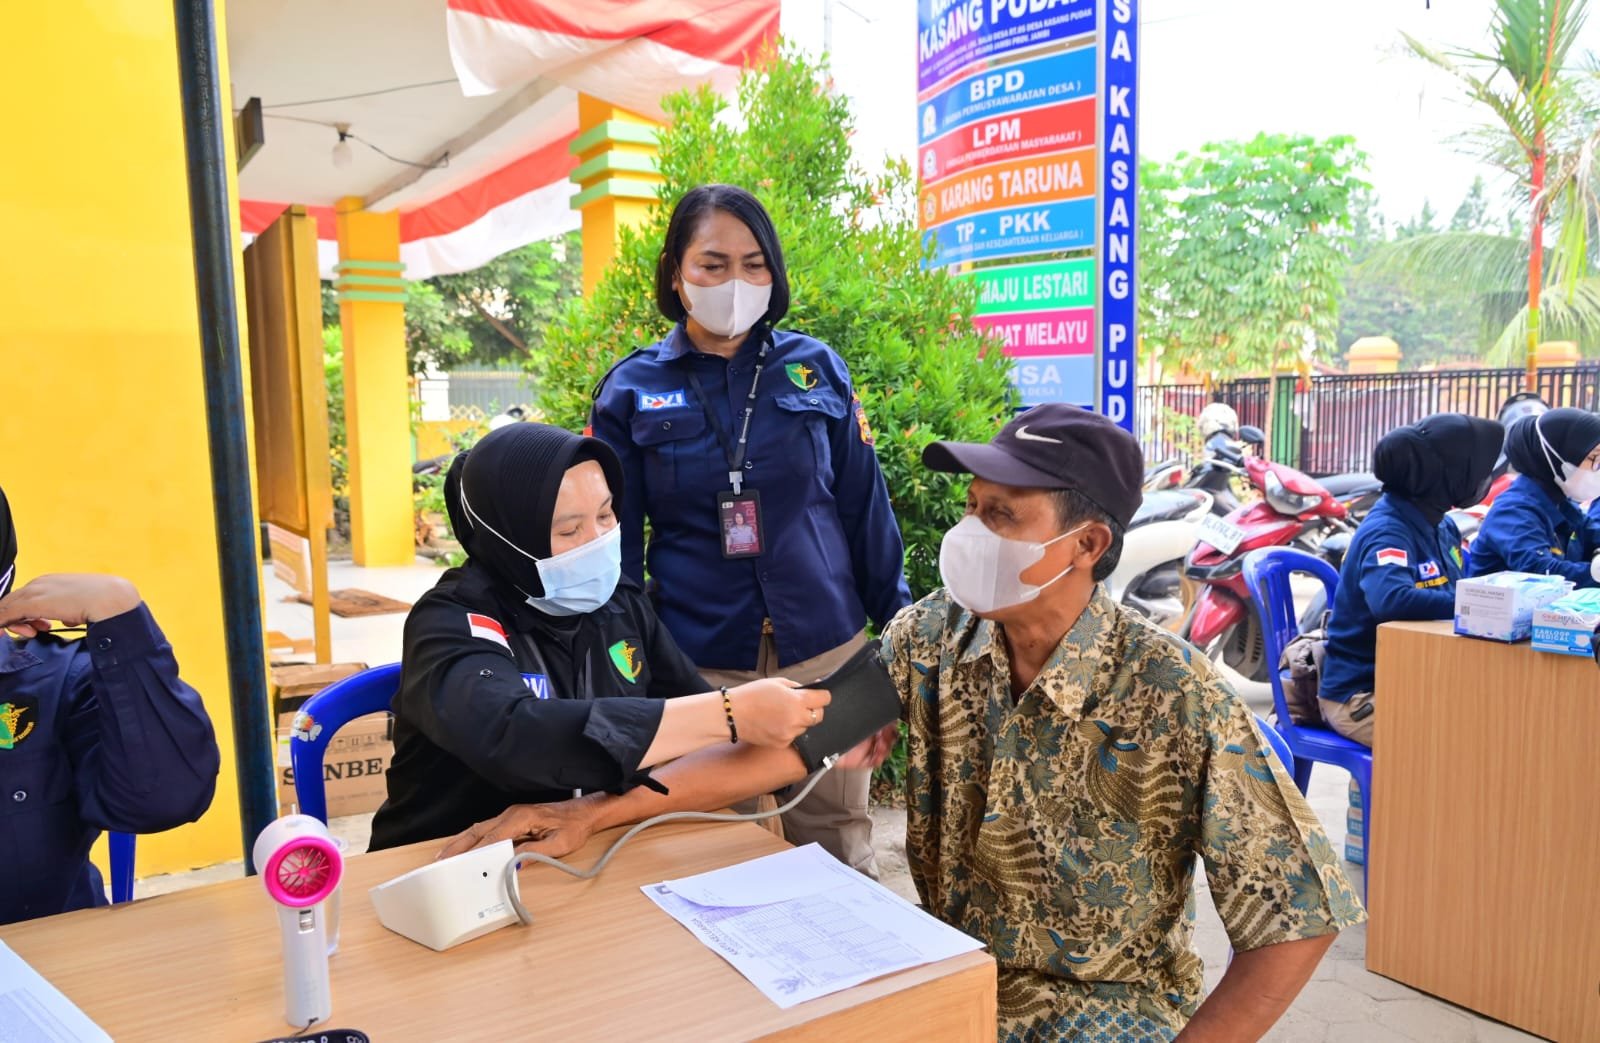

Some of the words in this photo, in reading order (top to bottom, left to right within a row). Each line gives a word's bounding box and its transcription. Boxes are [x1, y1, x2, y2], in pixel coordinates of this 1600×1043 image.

[919, 0, 984, 64] KASANG
[969, 70, 1025, 103] BPD
[1047, 81, 1075, 97] DESA
[972, 118, 1022, 148] LPM
[941, 174, 994, 213] KARANG
[999, 160, 1084, 198] TARUNA
[1108, 85, 1131, 299] KASANG
[955, 221, 975, 244] TP
[1000, 210, 1051, 236] PKK
[980, 277, 1019, 304] MAJU
[1023, 270, 1088, 301] LESTARI
[1025, 320, 1087, 346] MELAYU
